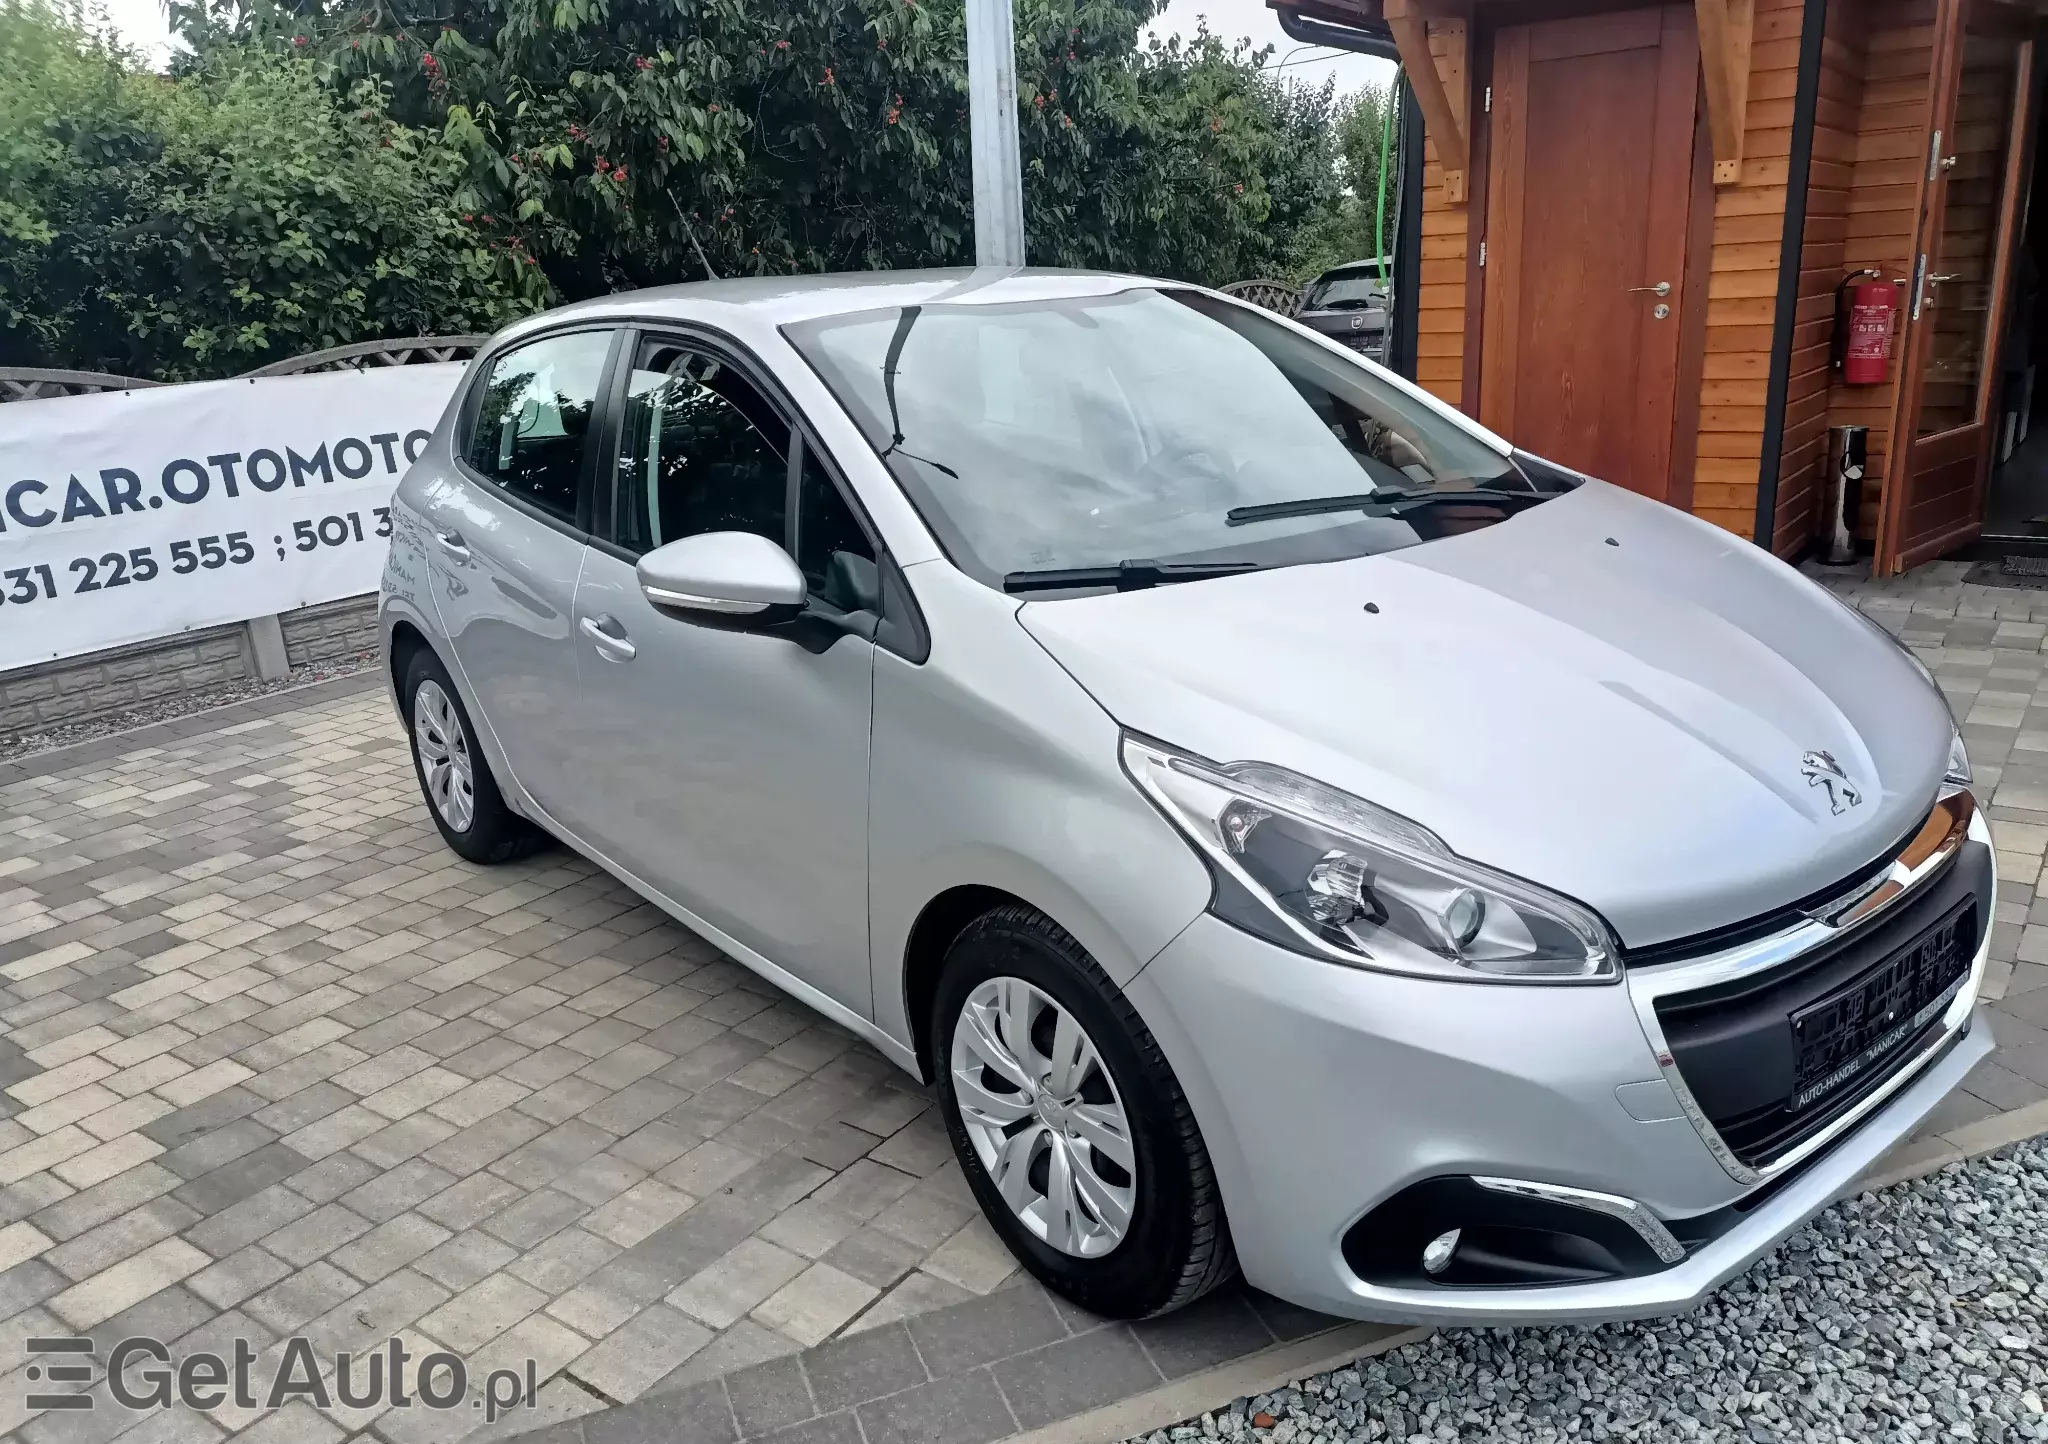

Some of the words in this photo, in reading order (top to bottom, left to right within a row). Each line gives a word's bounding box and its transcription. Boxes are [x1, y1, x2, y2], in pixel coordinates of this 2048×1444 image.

[0, 430, 433, 532] CAR.OTOMOTO
[0, 564, 57, 606] 31
[69, 547, 158, 594] 225
[171, 532, 254, 573] 555
[293, 512, 364, 551] 501
[1798, 1060, 1861, 1108] AUTO-HANDEL
[1866, 1024, 1908, 1060] "MANICAR"
